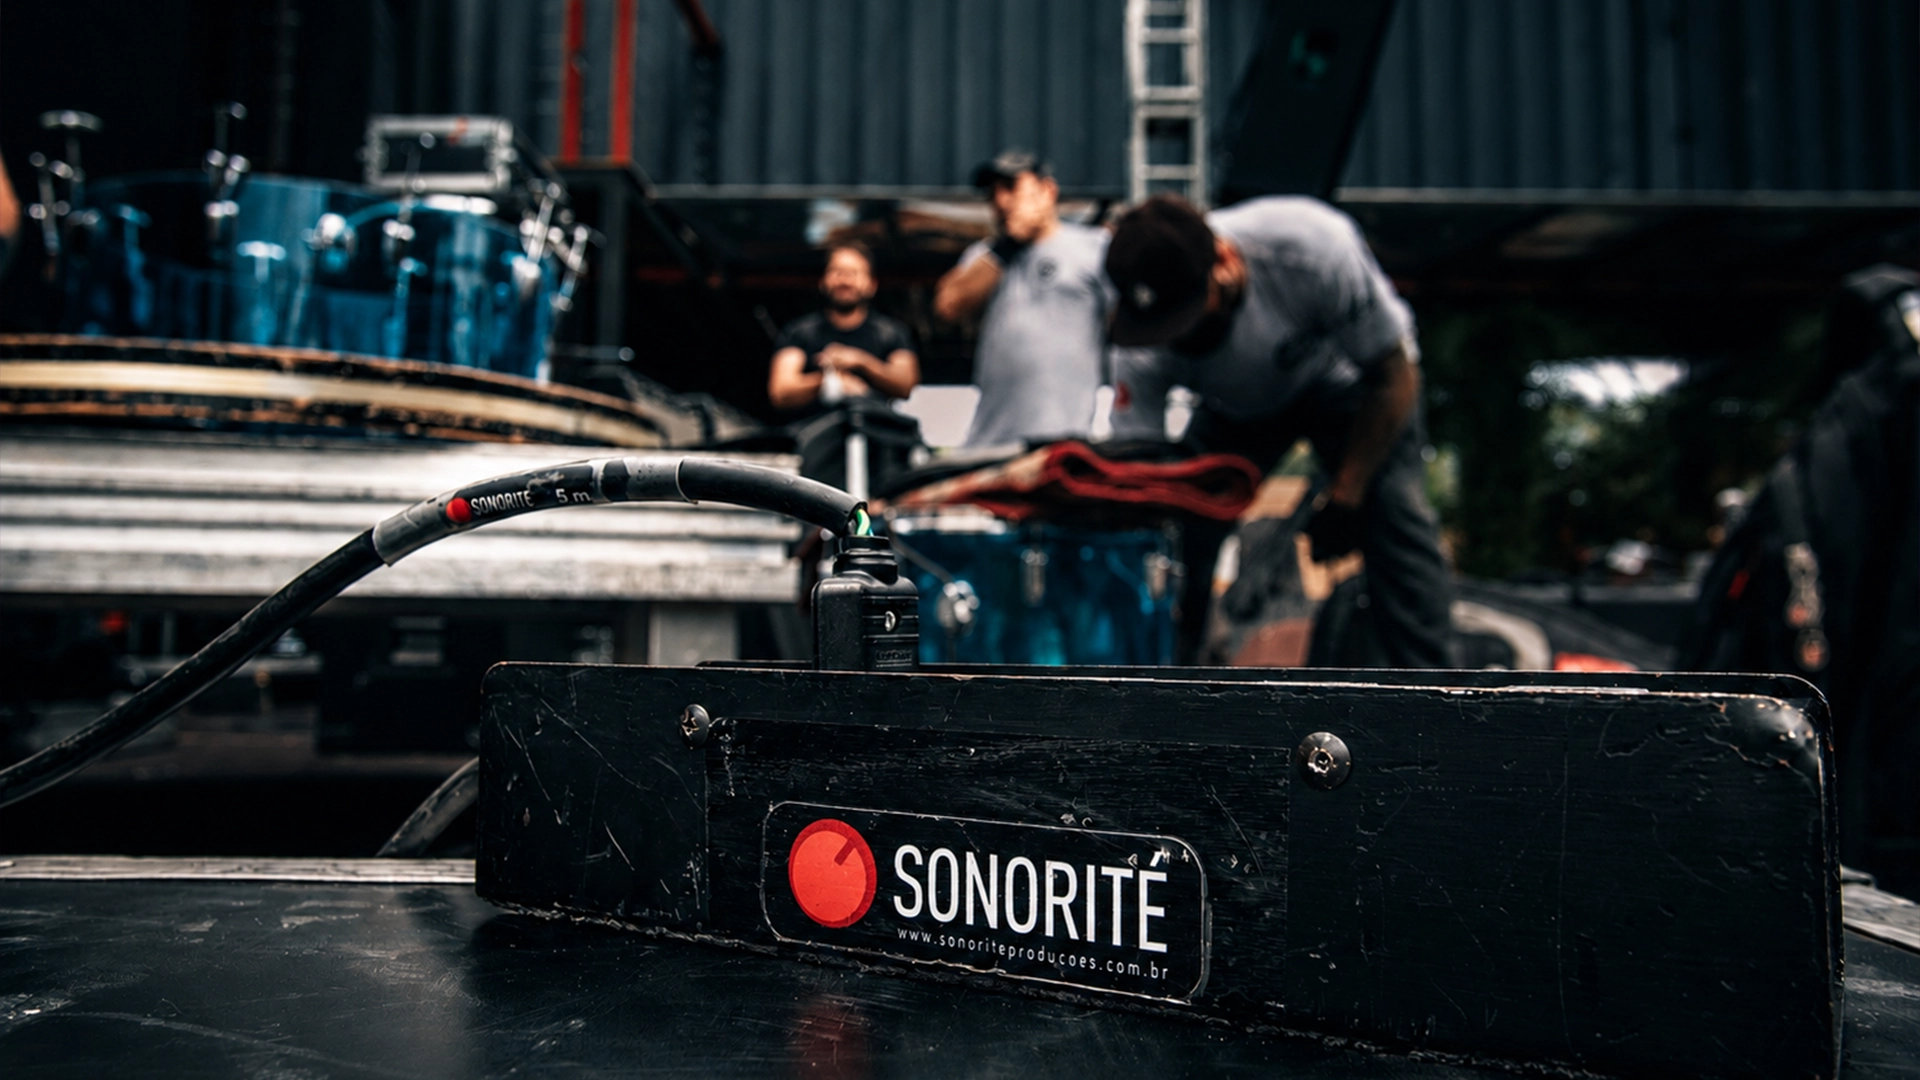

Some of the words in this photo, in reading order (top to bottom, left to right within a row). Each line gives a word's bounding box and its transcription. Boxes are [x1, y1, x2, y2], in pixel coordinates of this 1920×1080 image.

[555, 488, 569, 504] 5
[572, 490, 591, 503] m
[893, 843, 1168, 953] SONORITÉ
[897, 927, 1169, 980] www.sonoriteproducoes.com.br
